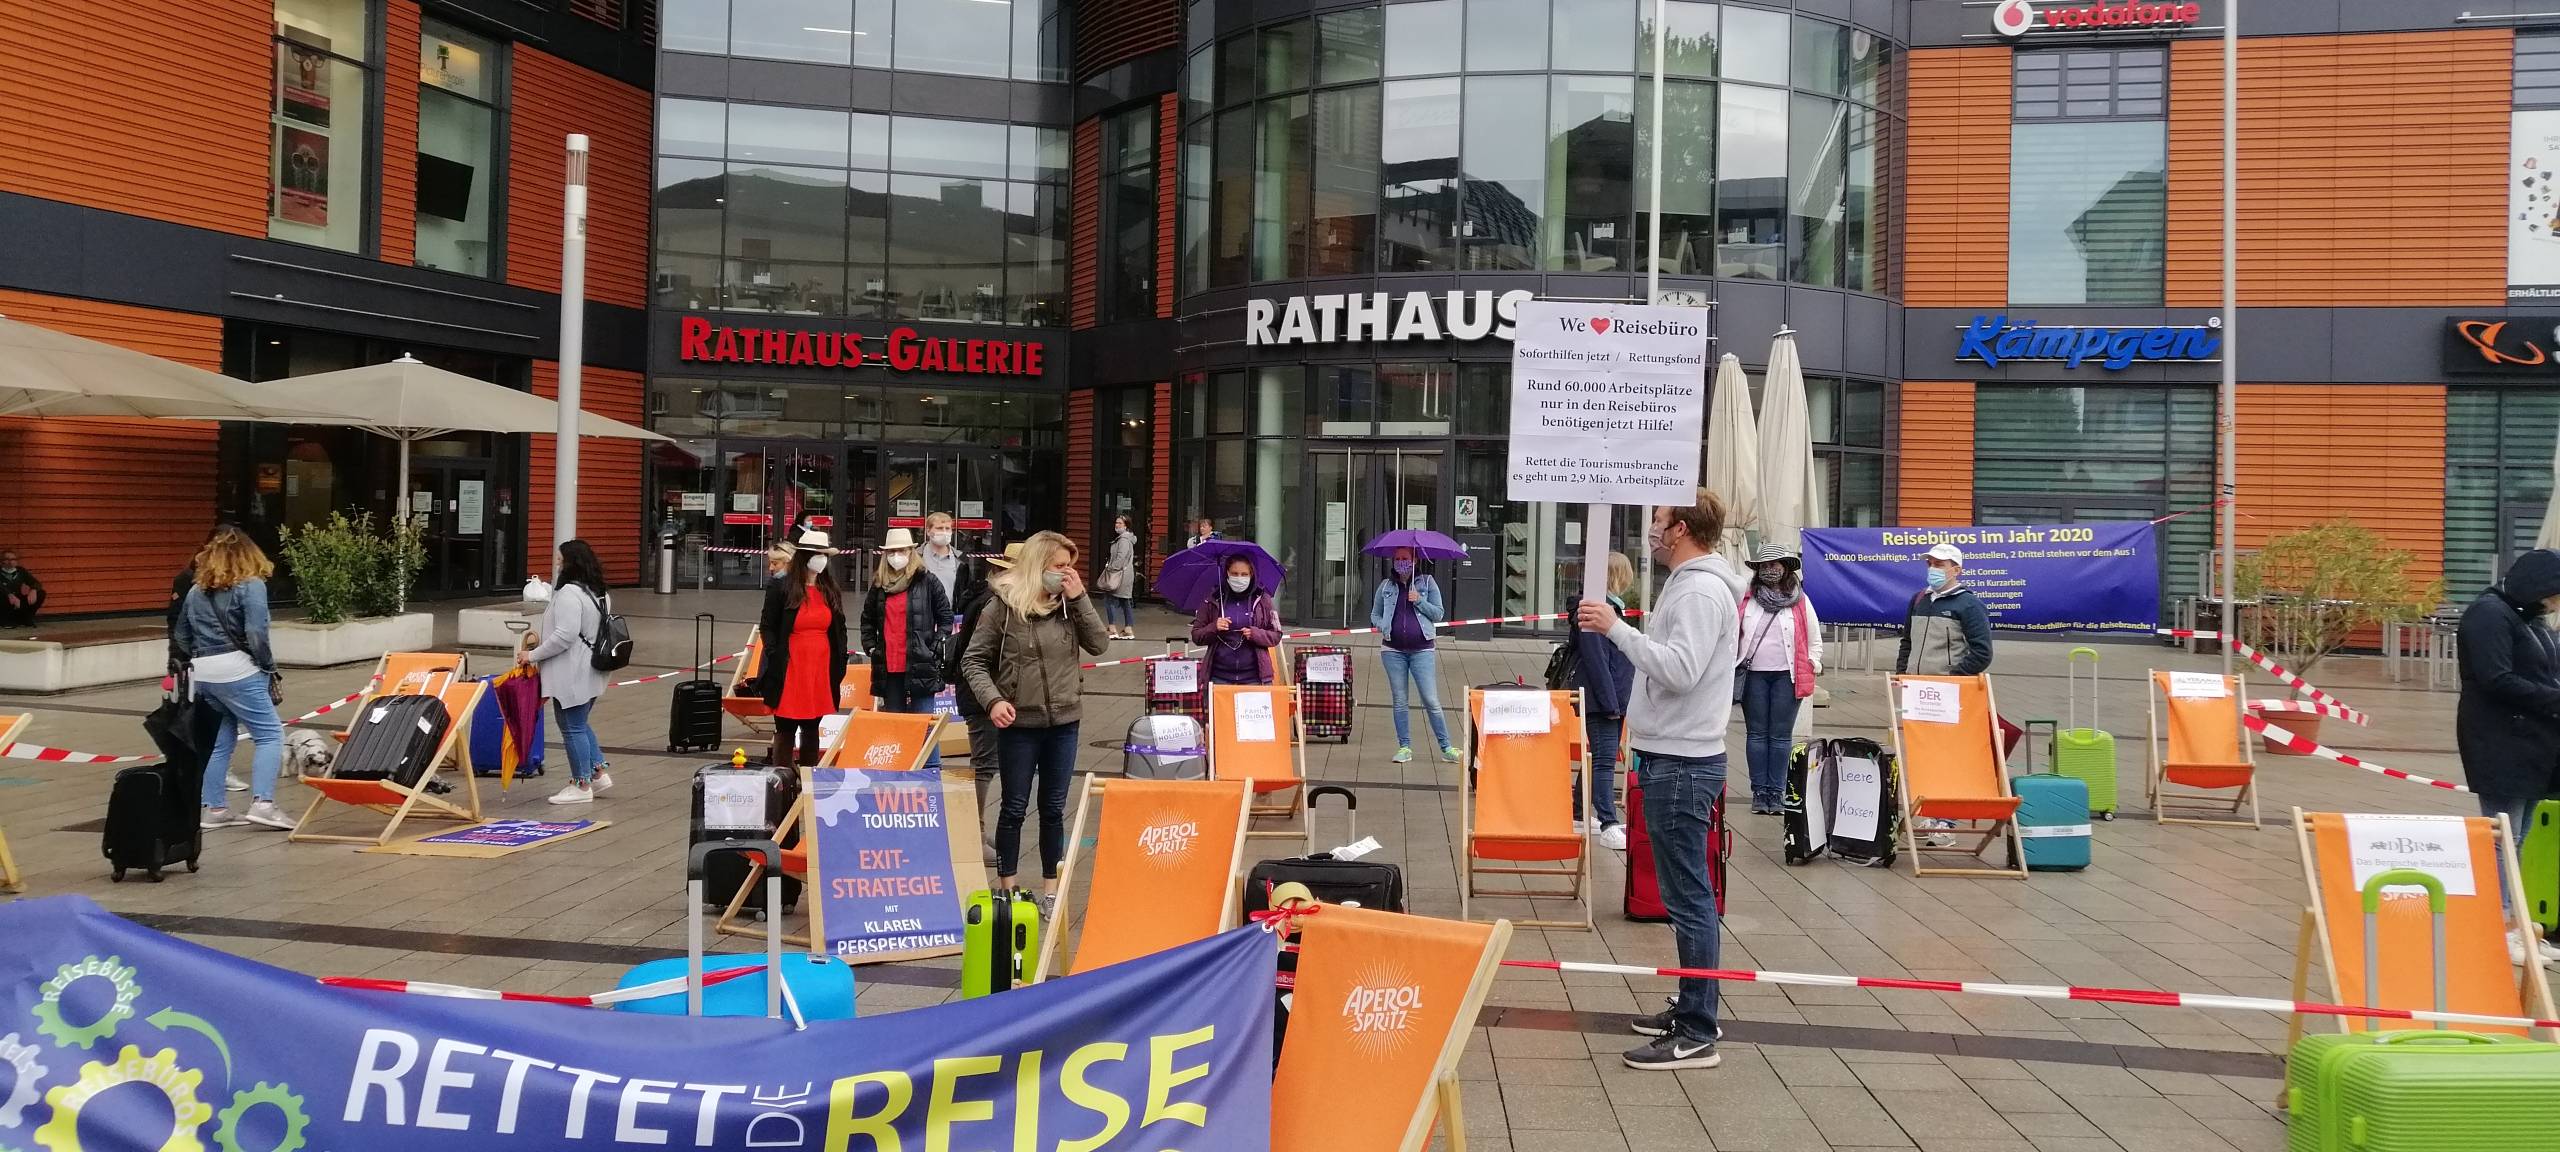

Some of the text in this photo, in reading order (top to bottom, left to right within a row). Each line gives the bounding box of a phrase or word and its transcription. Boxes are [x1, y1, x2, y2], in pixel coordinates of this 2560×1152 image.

[2043, 0, 2200, 27] vodafone
[1247, 289, 1534, 345] RATHAUS
[1559, 317, 1698, 337] We Reisebüro
[1956, 316, 2222, 369] Kämpgen
[1519, 348, 1584, 361] Soforthilfen
[1585, 350, 1610, 363] jetzt
[1628, 352, 1701, 366] Rettungsfond
[1527, 379, 1693, 398] Rund 60.000 Arbeitsplätze
[1540, 399, 1677, 413] nur in den Reisebüros
[1541, 415, 1674, 432] benötigen jetzt Hilfe!
[1525, 457, 1679, 471] Rettet die Tourismusbranche
[1525, 472, 1548, 483] geht
[1570, 473, 1586, 484] 2,9
[1588, 473, 1613, 483] Mio.
[1615, 475, 1685, 487] Arbeitsplätze
[1882, 528, 2094, 546] Reisebüros im Jahr 2020
[1824, 553, 1856, 562] 100.000
[1857, 553, 1910, 563] Beschäftigte,
[1961, 551, 2009, 560] iebsstellen,
[2010, 551, 2017, 559] 2
[2018, 550, 2046, 559] Drittel
[2046, 550, 2075, 558] stehen
[2092, 549, 2112, 557] dem
[1961, 568, 2008, 576] Seit Corona:
[1977, 579, 1985, 587] in
[1986, 578, 2026, 587] Kurzarbeit
[2100, 621, 2151, 630] Reisebranche
[1919, 689, 1941, 701] DER
[1158, 731, 1193, 742] HOLIDAYS
[864, 743, 902, 760] APEROL
[867, 755, 894, 767] SPRITZ
[1840, 765, 1874, 784] Leere
[873, 787, 930, 814] WIR
[1840, 797, 1874, 818] Kassen
[862, 813, 940, 829] TOURISTIK
[1138, 821, 1200, 847] APEROL
[1146, 838, 1189, 856] SPRITZ
[858, 849, 910, 870] EXIT-
[2356, 858, 2467, 869] Das Bergische Reisebüro
[832, 875, 944, 899] STRATEGIE
[884, 905, 899, 913] MIT
[863, 918, 923, 933] KLAREN
[837, 934, 956, 955] PERSPEKTIVEN
[42, 960, 136, 1015] REISEBUSSE
[1342, 985, 1423, 1017] APEROL
[1352, 1009, 1408, 1032] SPRITZ
[343, 1024, 1214, 1152] RETTET DIE REISE
[60, 1058, 200, 1137] REISEBÜROS
